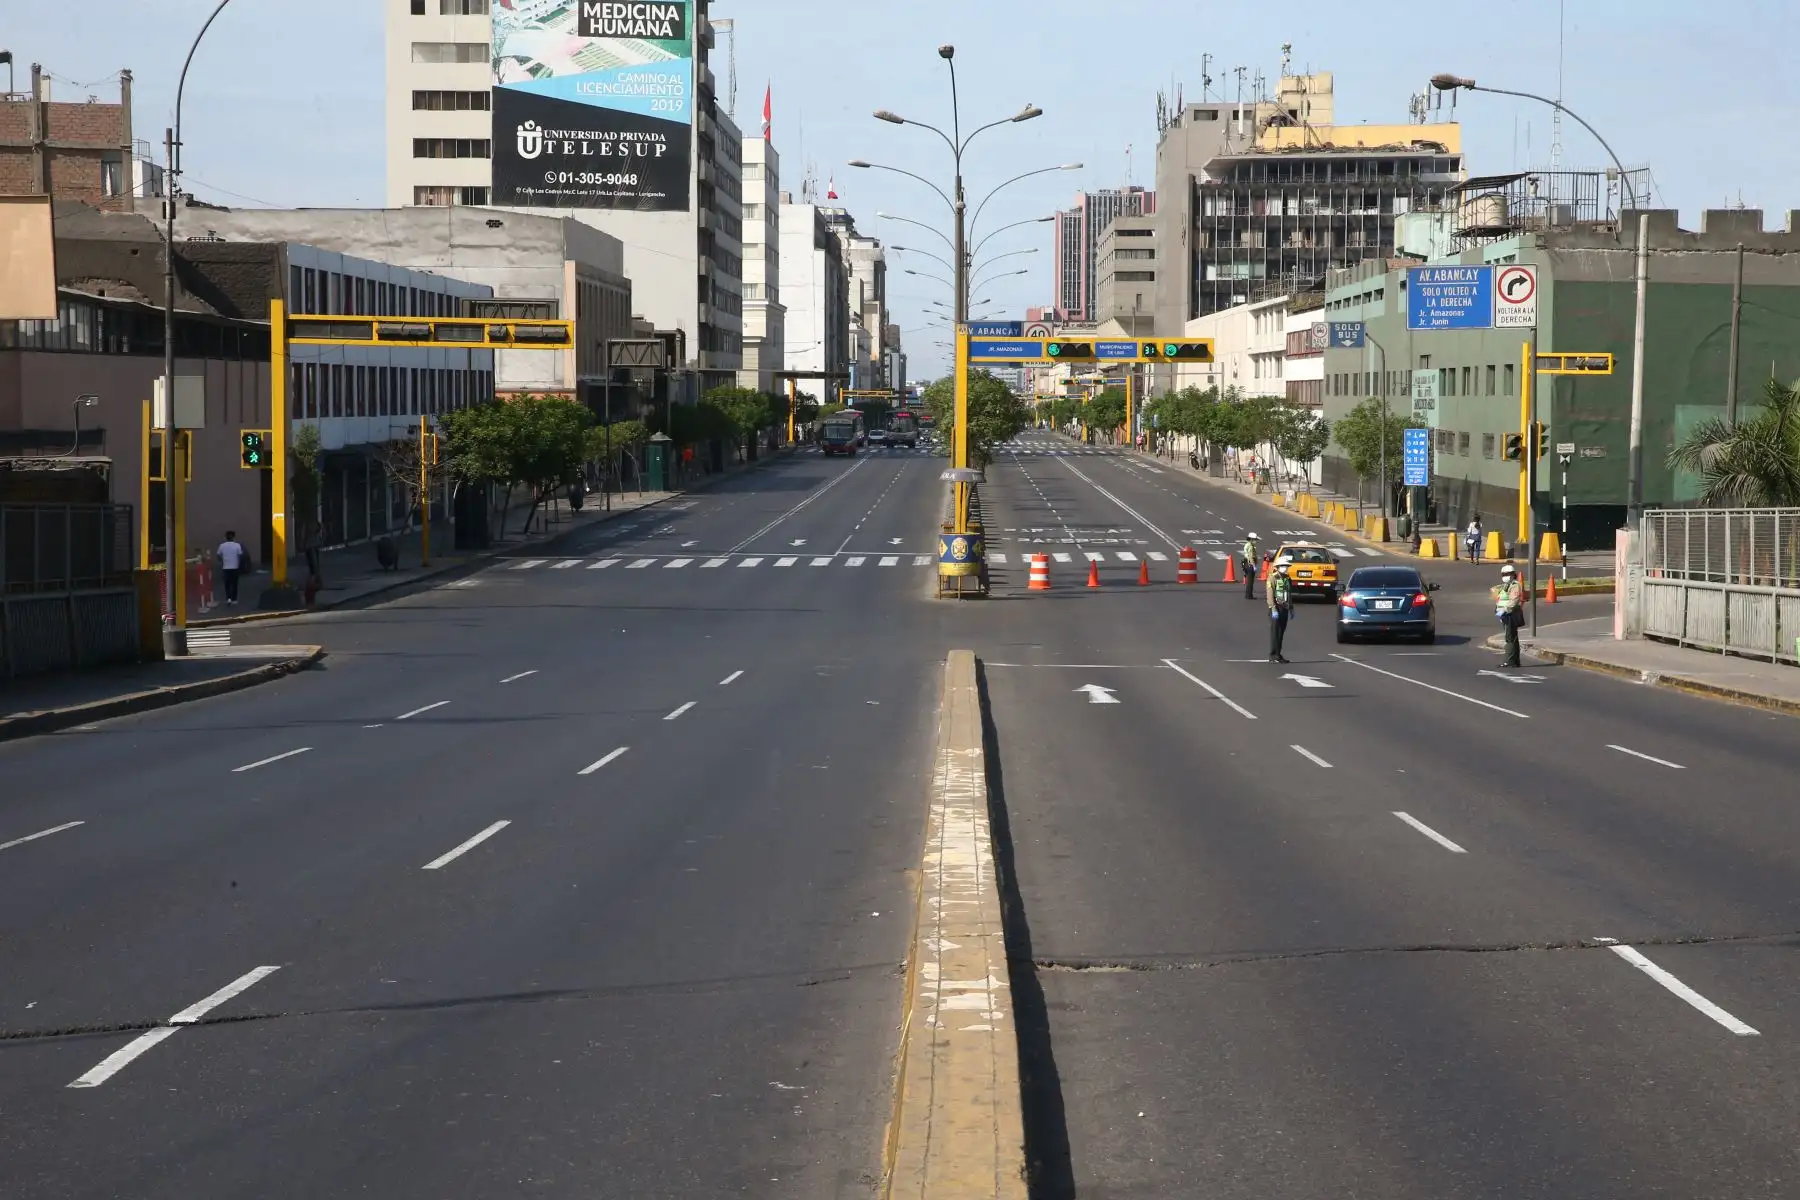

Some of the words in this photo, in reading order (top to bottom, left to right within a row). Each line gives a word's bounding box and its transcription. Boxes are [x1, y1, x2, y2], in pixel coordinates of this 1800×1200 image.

[584, 2, 680, 21] MEDICINA
[590, 18, 673, 36] HUMANA
[618, 73, 666, 84] CAMINO
[668, 74, 683, 84] AL
[576, 82, 684, 95] LICENCIAMIENTO
[651, 99, 683, 112] 2019
[544, 130, 617, 140] UNIVERSIDAD
[620, 132, 666, 141] PRIVADA
[544, 140, 667, 157] TELESUP
[559, 172, 638, 185] 01-305-9048
[1419, 270, 1431, 281] AV.
[1434, 269, 1479, 281] ABANCAY
[1422, 287, 1440, 296] SOLO
[1444, 286, 1469, 296] VOLTEO
[1472, 286, 1477, 295] A
[1427, 298, 1436, 307] LA
[1441, 297, 1472, 307] DERECHA
[248, 436, 258, 445] 31
